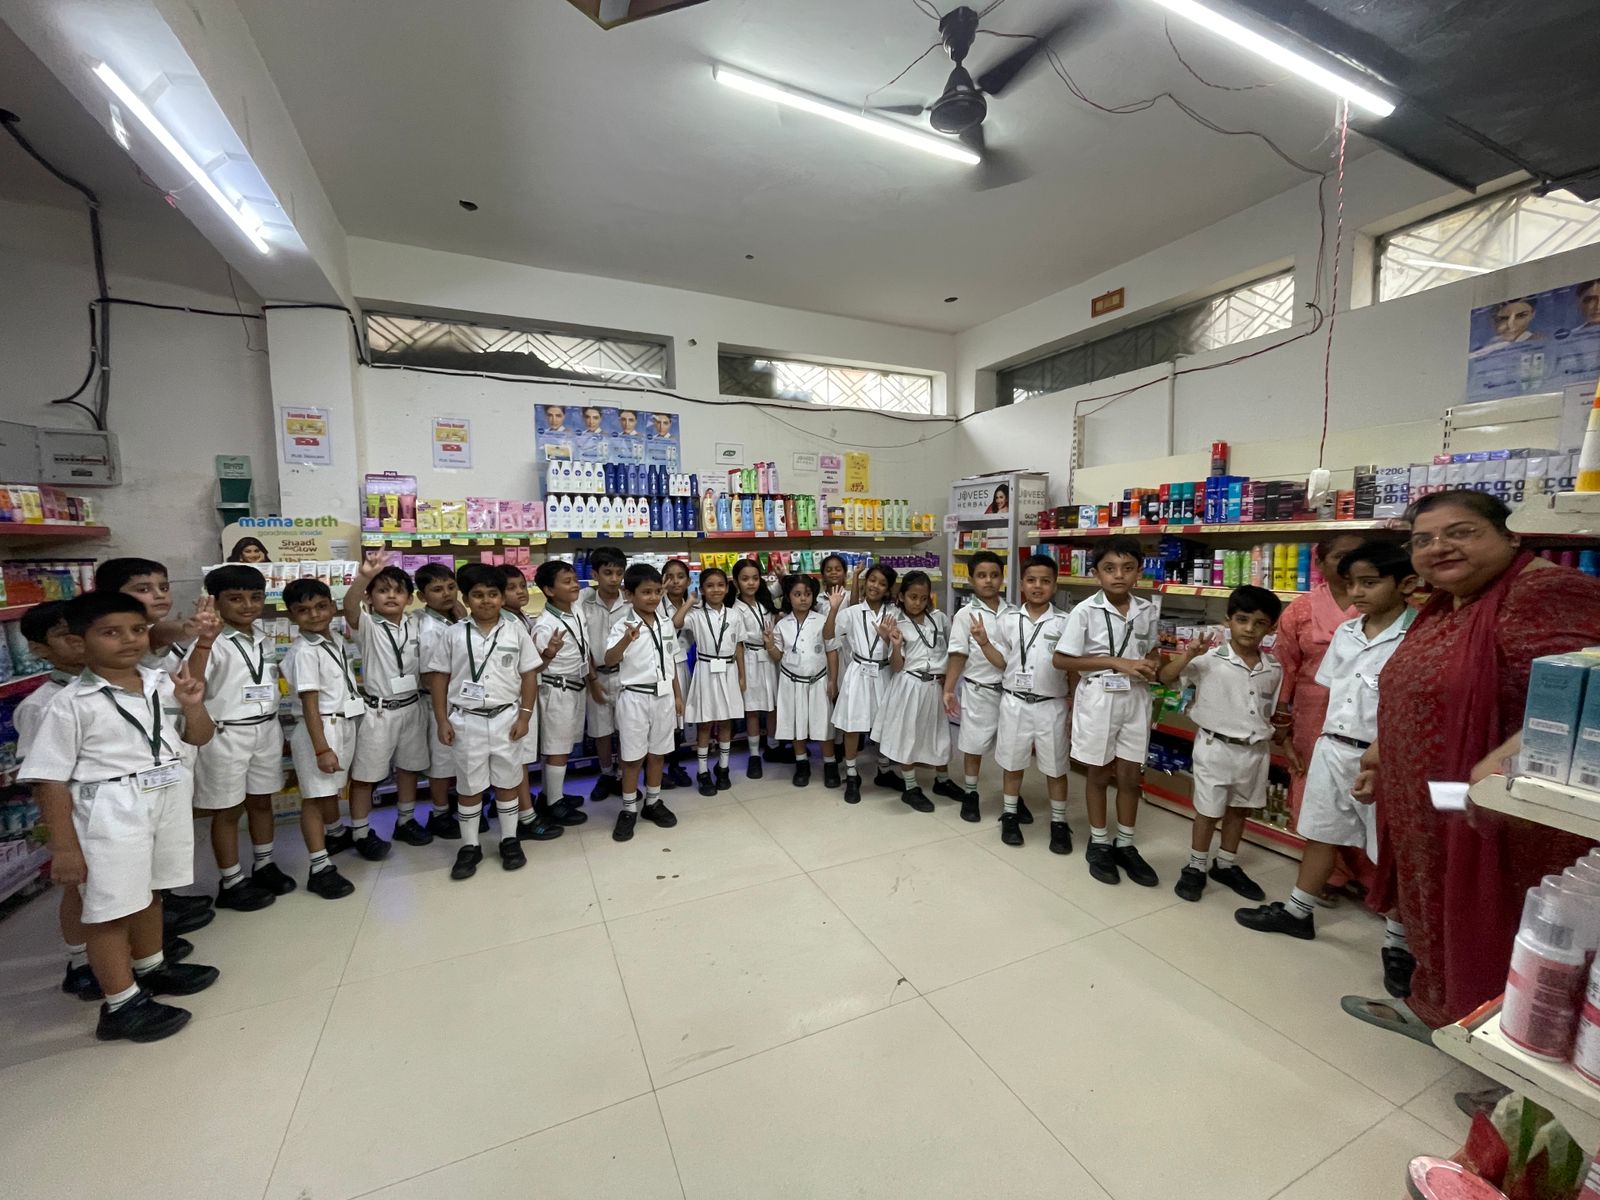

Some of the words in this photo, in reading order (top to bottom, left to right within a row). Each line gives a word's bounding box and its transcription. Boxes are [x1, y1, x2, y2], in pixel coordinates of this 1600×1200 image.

[957, 489, 989, 501] JOVEES
[1019, 490, 1046, 499] JOVEES
[957, 501, 988, 509] HERBAL
[239, 515, 339, 528] mamaearth
[257, 530, 299, 538] goodness
[281, 538, 316, 547] Shaadi
